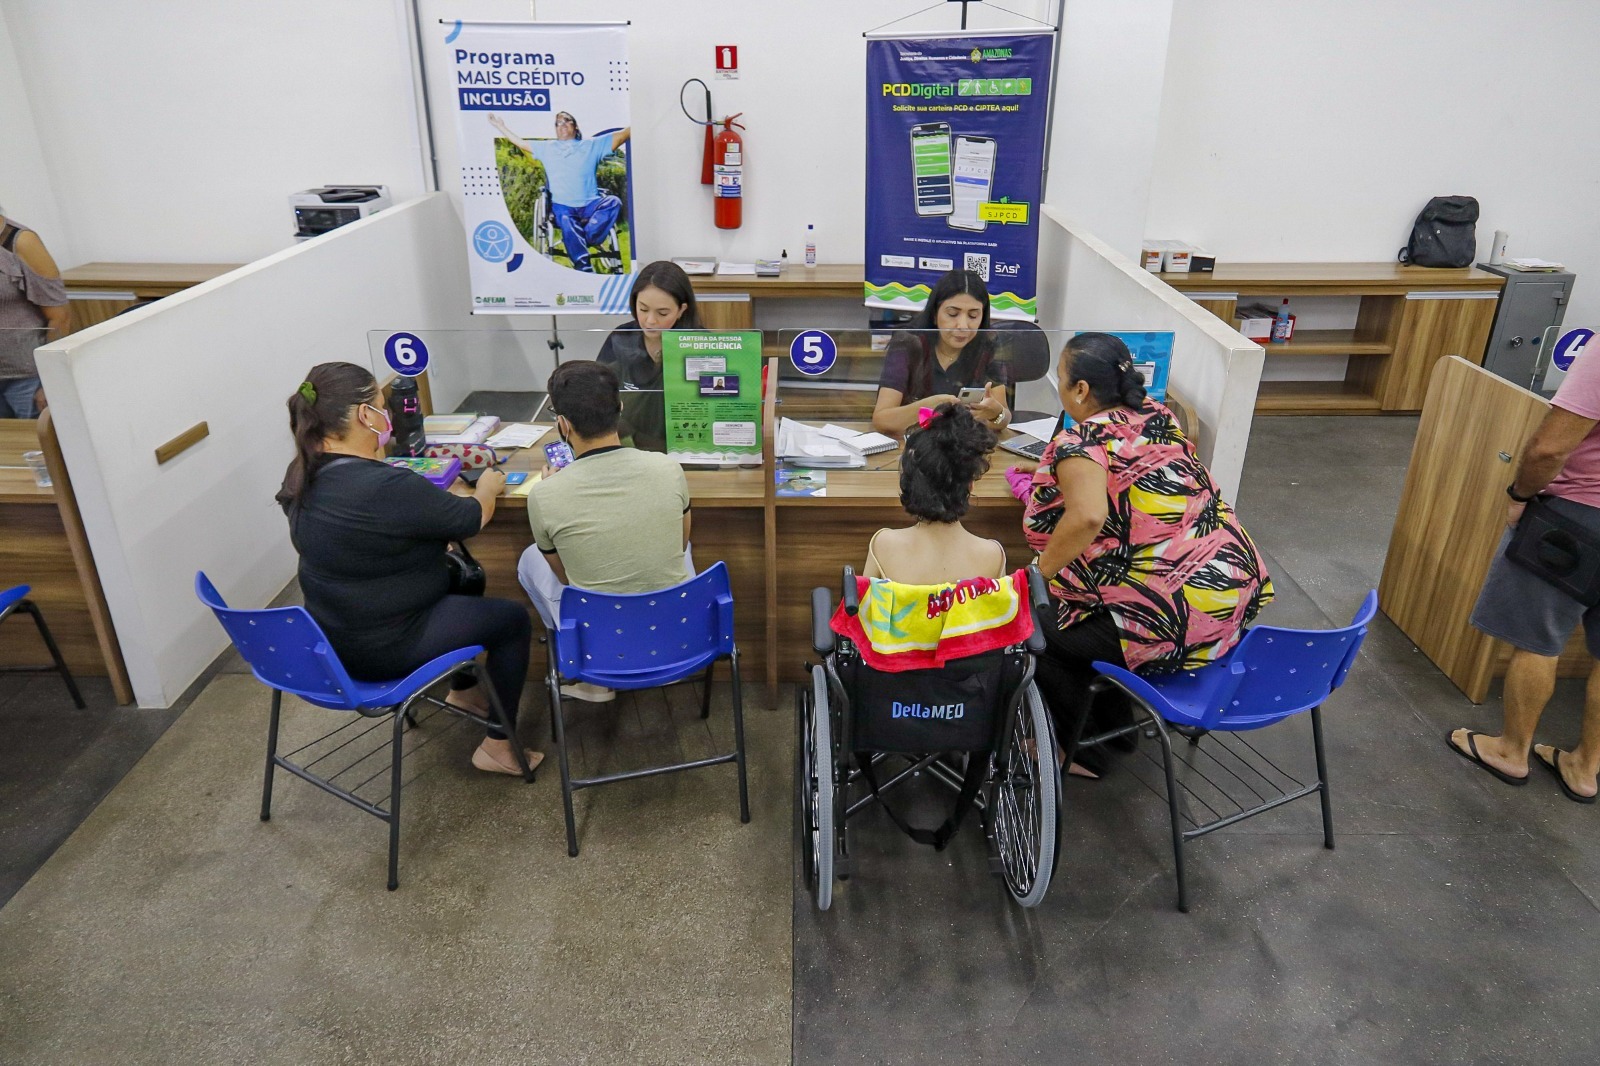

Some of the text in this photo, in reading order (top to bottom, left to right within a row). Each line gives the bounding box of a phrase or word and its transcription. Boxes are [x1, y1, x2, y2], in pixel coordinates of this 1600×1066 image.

[455, 49, 555, 68] Programa
[982, 48, 1012, 58] AMAZONAS
[457, 68, 585, 86] MAIS CRÉDITO
[463, 90, 547, 106] INCLUSÃO
[882, 83, 954, 100] PCDDigital
[566, 296, 594, 304] AMAZONAS
[394, 338, 417, 366] 6
[694, 342, 742, 350] DEFICIÊNCIA
[802, 336, 824, 364] 5
[1564, 334, 1586, 356] 4
[892, 701, 964, 720] DellaMED
